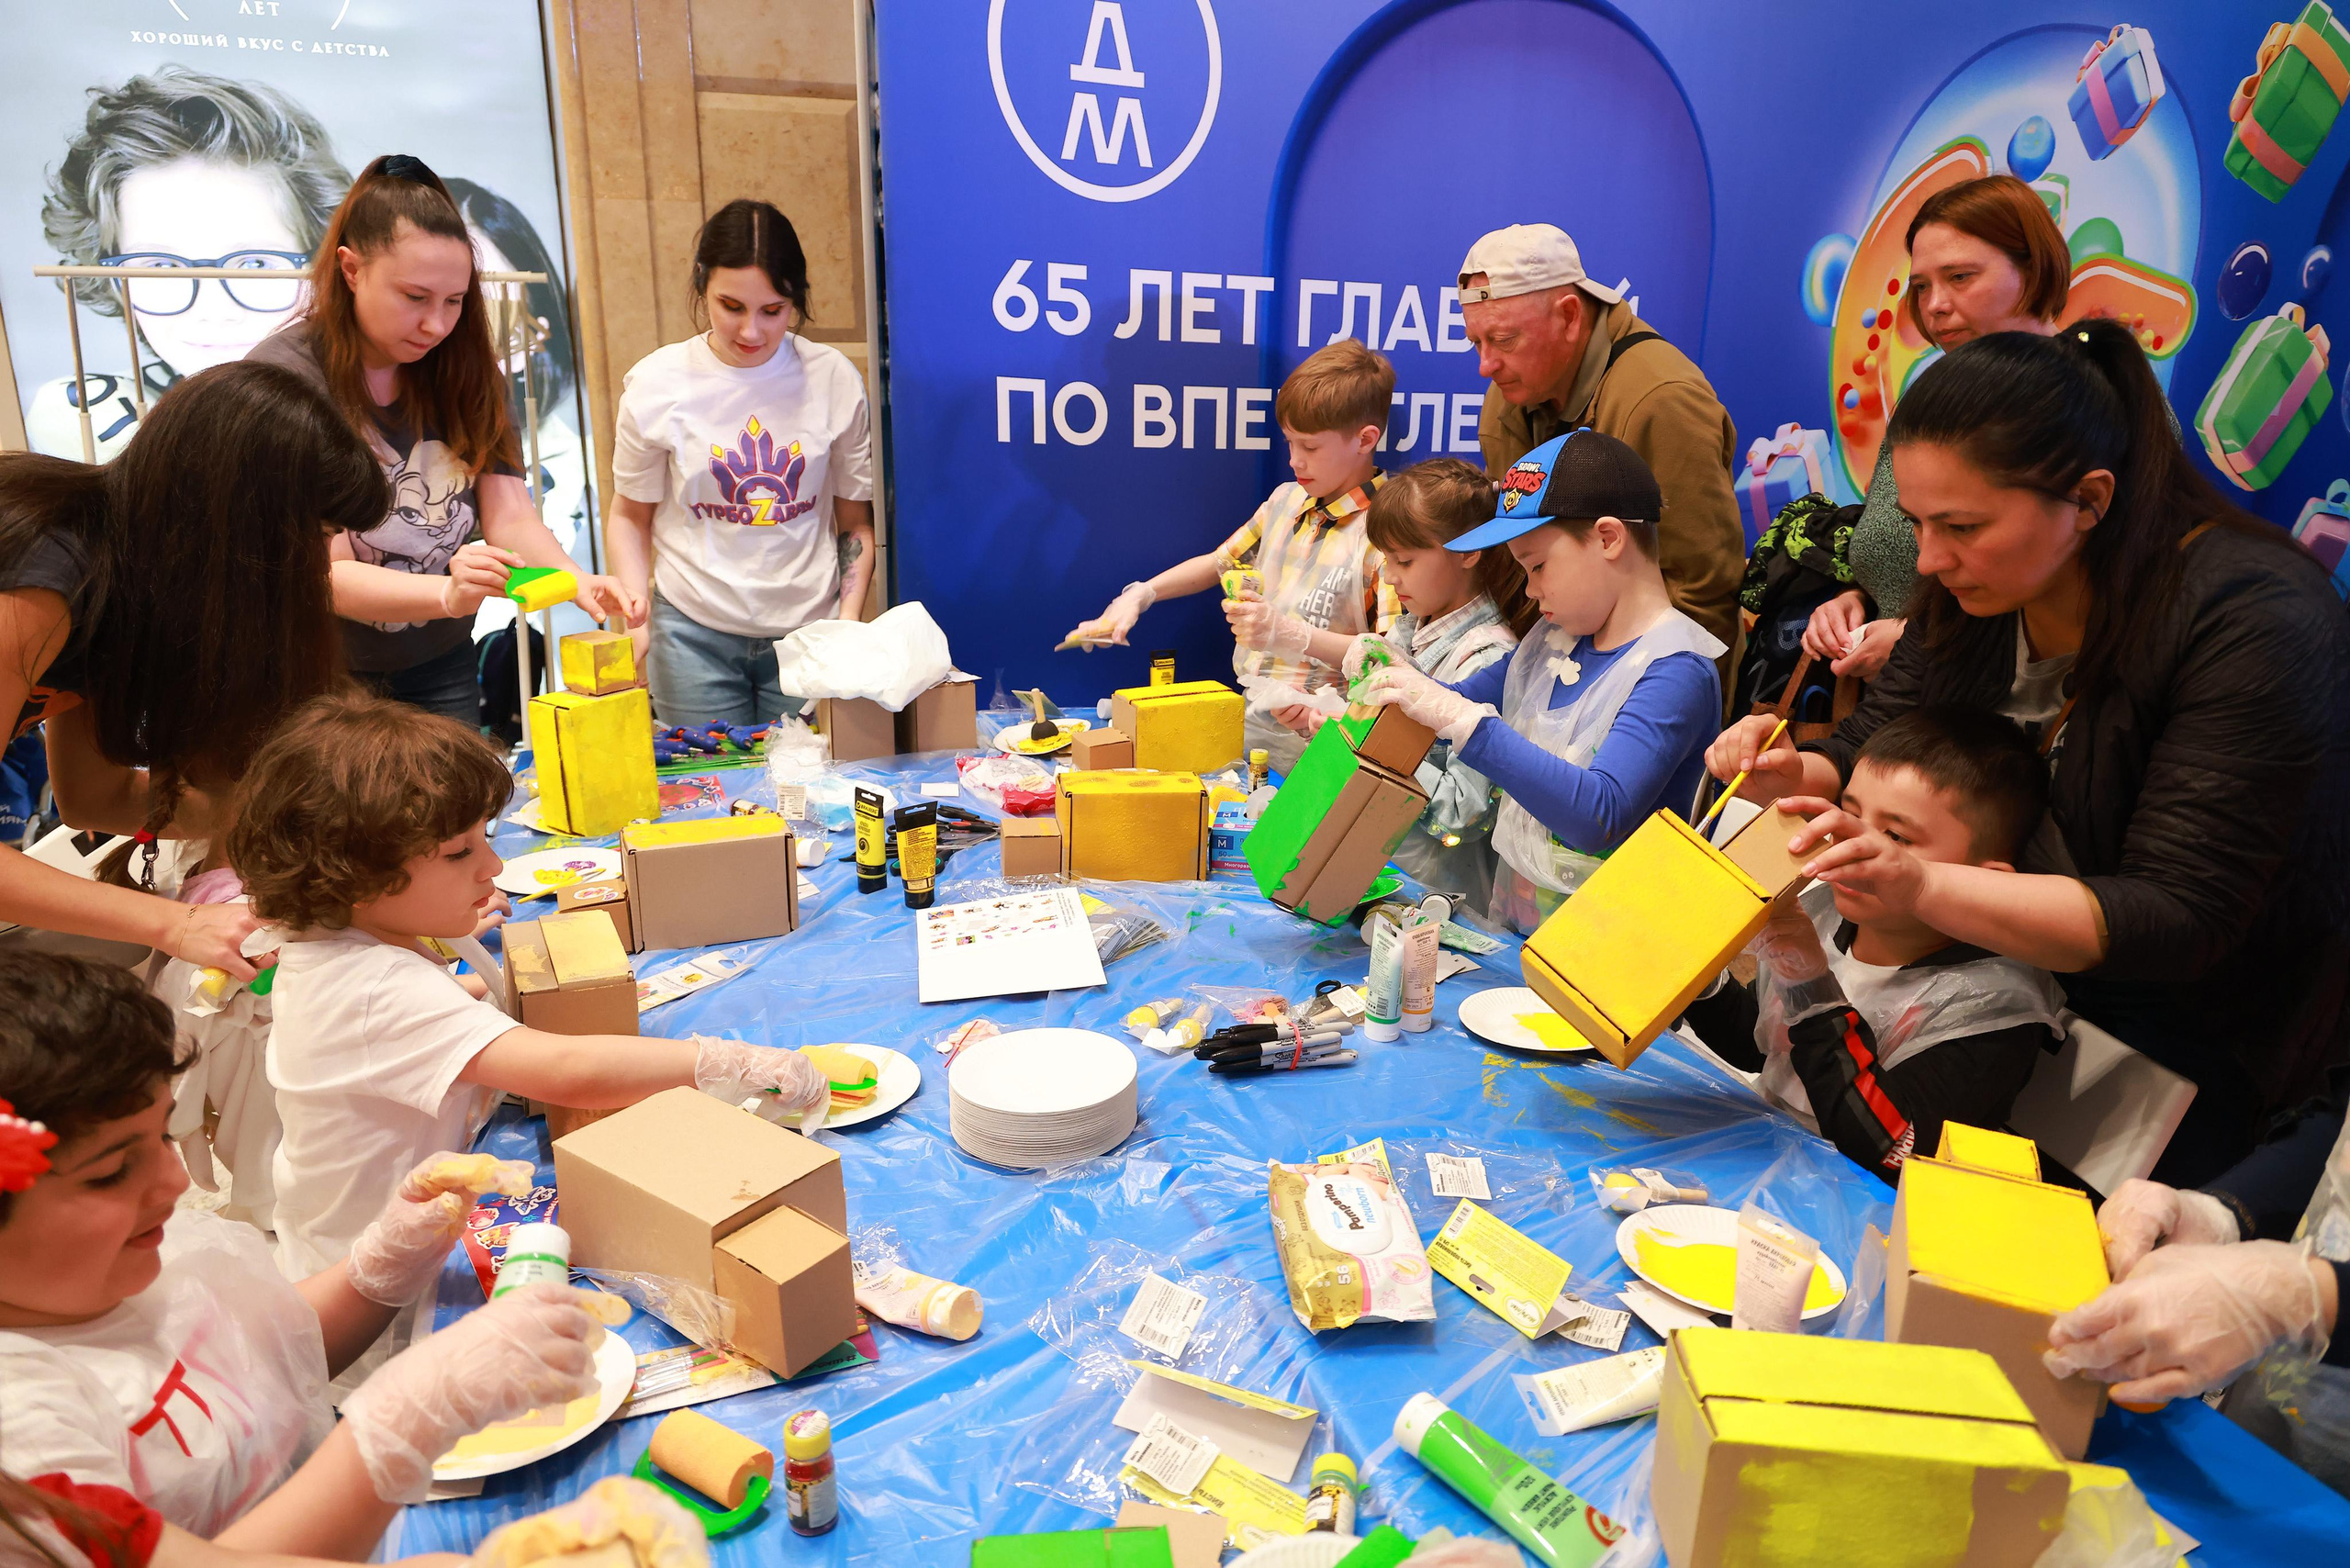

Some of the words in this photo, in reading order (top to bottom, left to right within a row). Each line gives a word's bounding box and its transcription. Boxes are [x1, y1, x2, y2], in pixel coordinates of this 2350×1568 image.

[238, 0, 280, 17] ЛЕТ
[129, 30, 229, 48] ХОРОШИЙ
[237, 37, 285, 51] ВКУС
[291, 40, 304, 52] С
[311, 41, 390, 57] ДЕТСТВА
[991, 258, 1091, 336] 65
[1113, 268, 1275, 345] ЛЕТ
[996, 375, 1108, 446] ПО
[1502, 467, 1548, 496] STARS
[1324, 1183, 1364, 1230] Pamperino
[1356, 1187, 1376, 1224] newborn
[1336, 1264, 1352, 1285] 56
